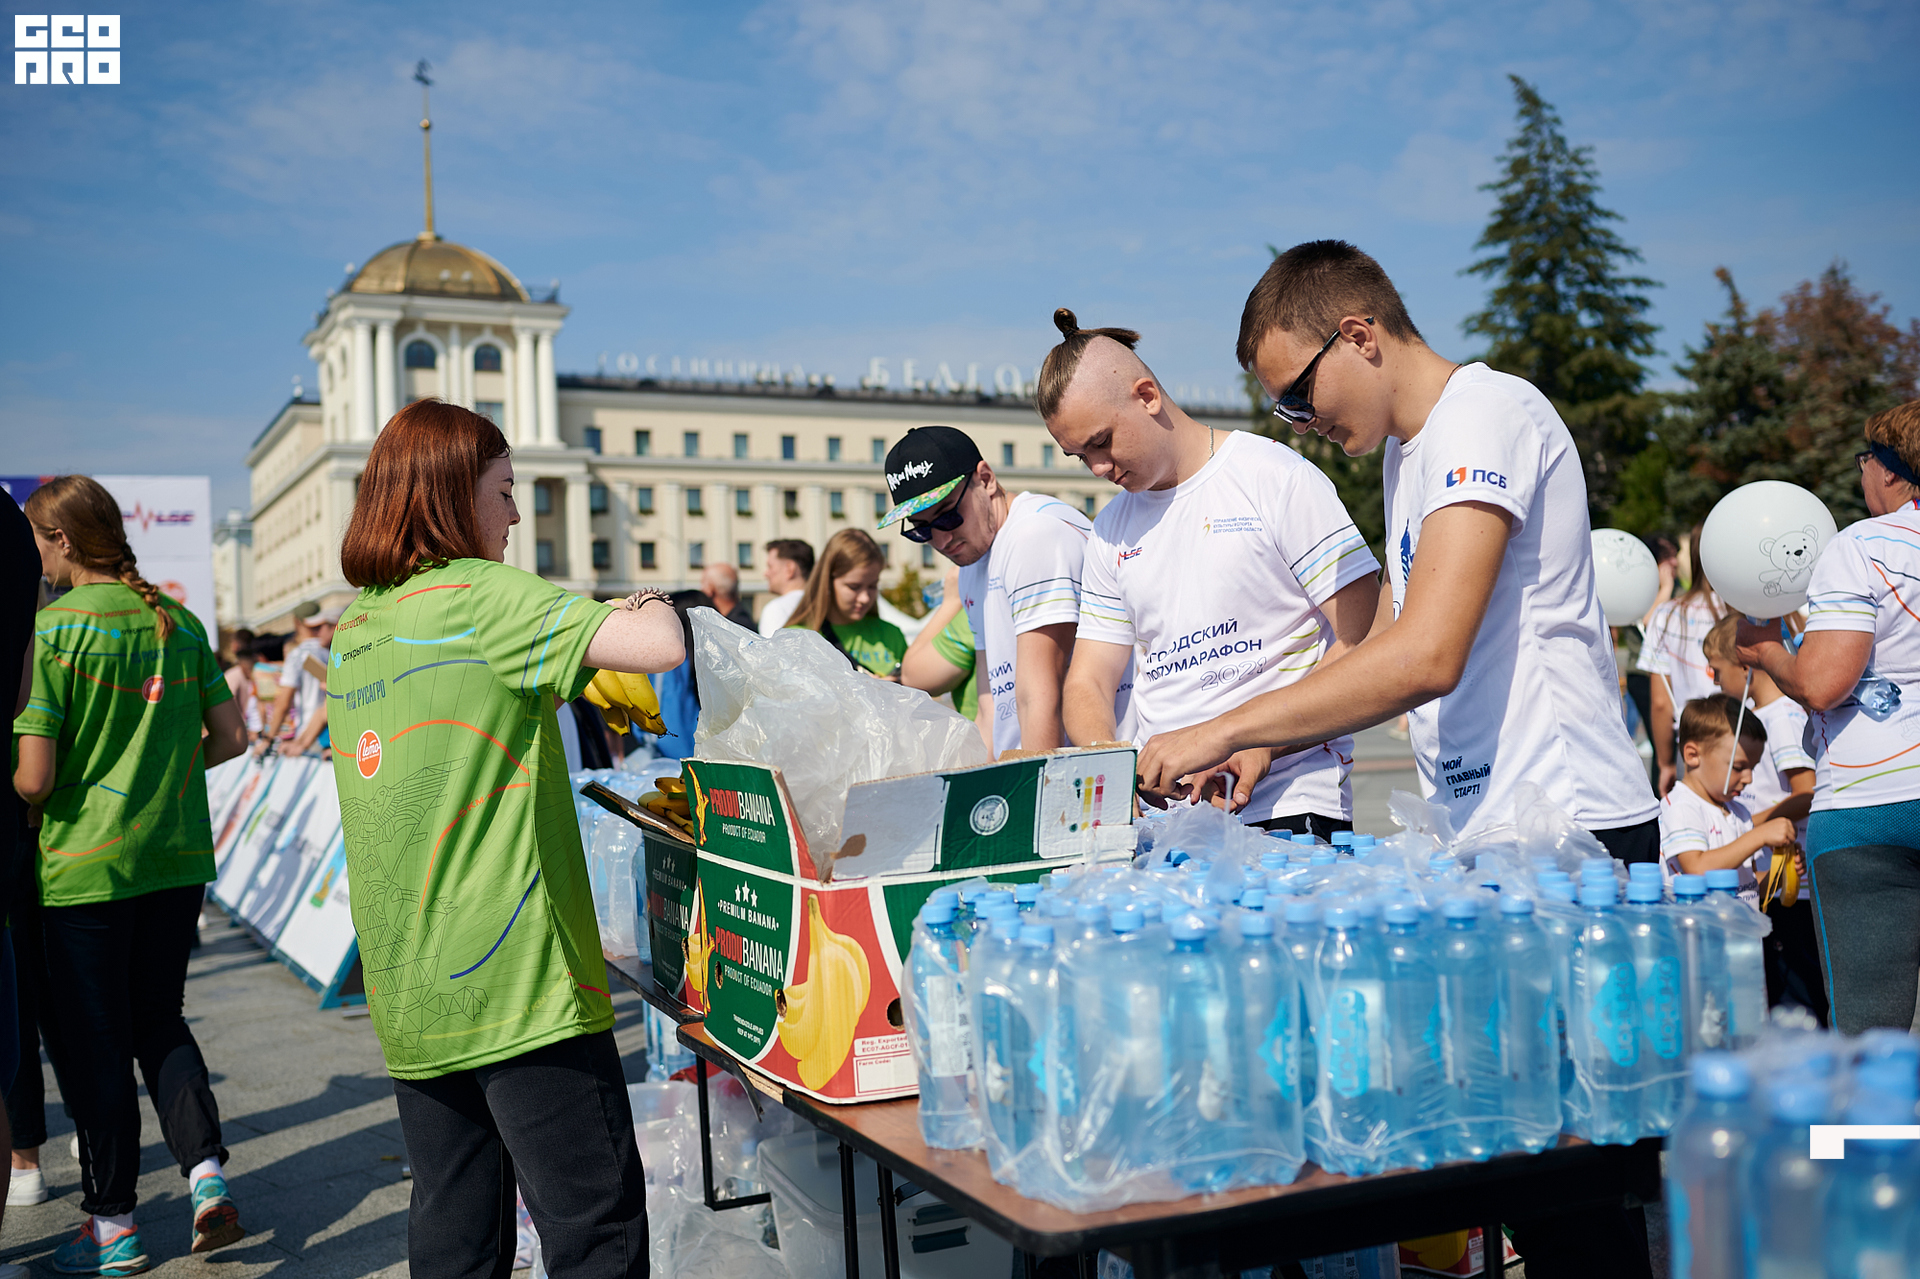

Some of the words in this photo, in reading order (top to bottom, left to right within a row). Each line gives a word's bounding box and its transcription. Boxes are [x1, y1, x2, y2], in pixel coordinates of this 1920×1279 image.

[869, 356, 1043, 396] БЕЛГО
[1472, 468, 1507, 489] ПСБ
[357, 679, 386, 707] РУСАГРО
[1441, 755, 1463, 771] МОЙ
[1445, 763, 1491, 785] ГЛАВНЫЙ
[1454, 783, 1480, 798] СТАРТ!
[709, 787, 776, 826] PRODUBANANA
[722, 822, 741, 838] PRODUCT
[741, 826, 748, 839] OF
[719, 899, 746, 921] PREMIUM
[747, 909, 777, 932] BANANA
[715, 926, 785, 983] PRODUBANANA
[724, 964, 743, 984] PRODUCT
[743, 973, 750, 987] OF
[750, 976, 773, 998] ECUADOR
